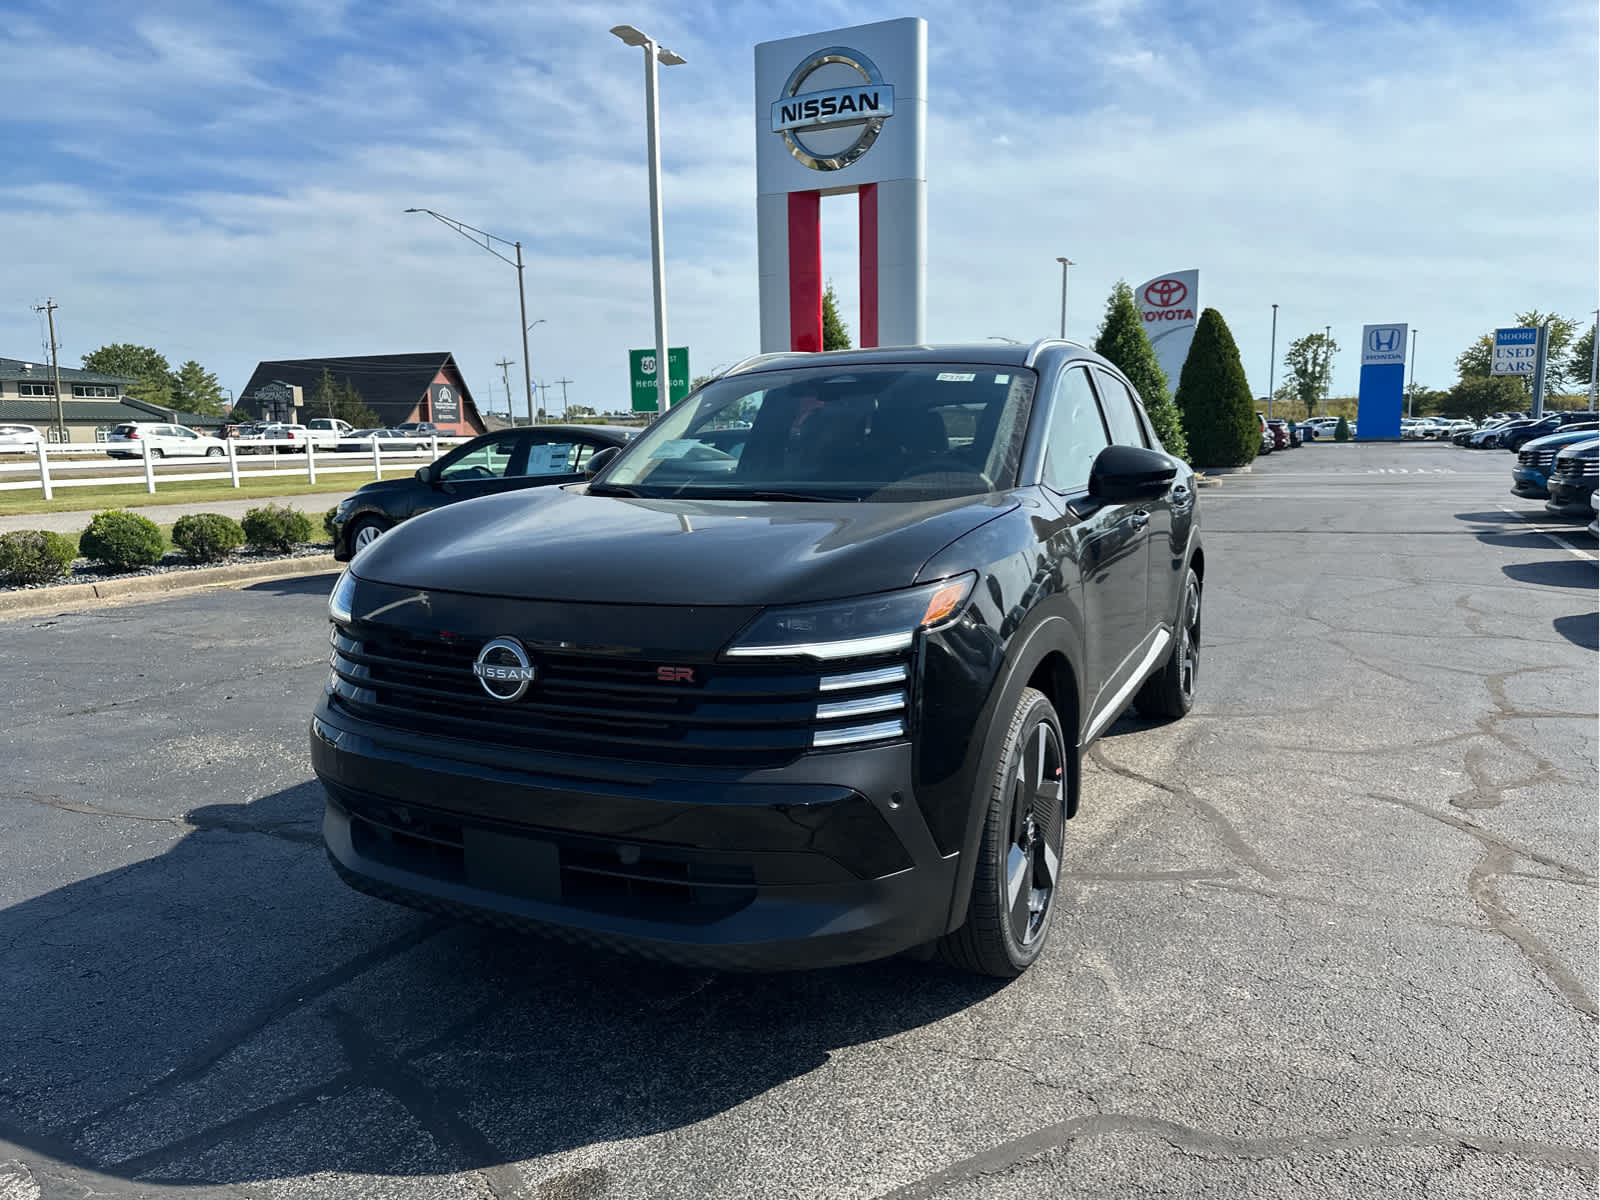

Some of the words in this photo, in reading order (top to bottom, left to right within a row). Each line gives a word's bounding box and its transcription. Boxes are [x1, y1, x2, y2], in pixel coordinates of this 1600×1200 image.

[781, 92, 879, 123] NISSAN
[1143, 309, 1194, 322] OYOTA
[1499, 332, 1535, 341] MOORE
[1496, 347, 1536, 358] USED
[642, 359, 655, 371] 60
[1494, 361, 1535, 371] CARS
[473, 664, 533, 680] NISSAN
[657, 666, 696, 682] SR
